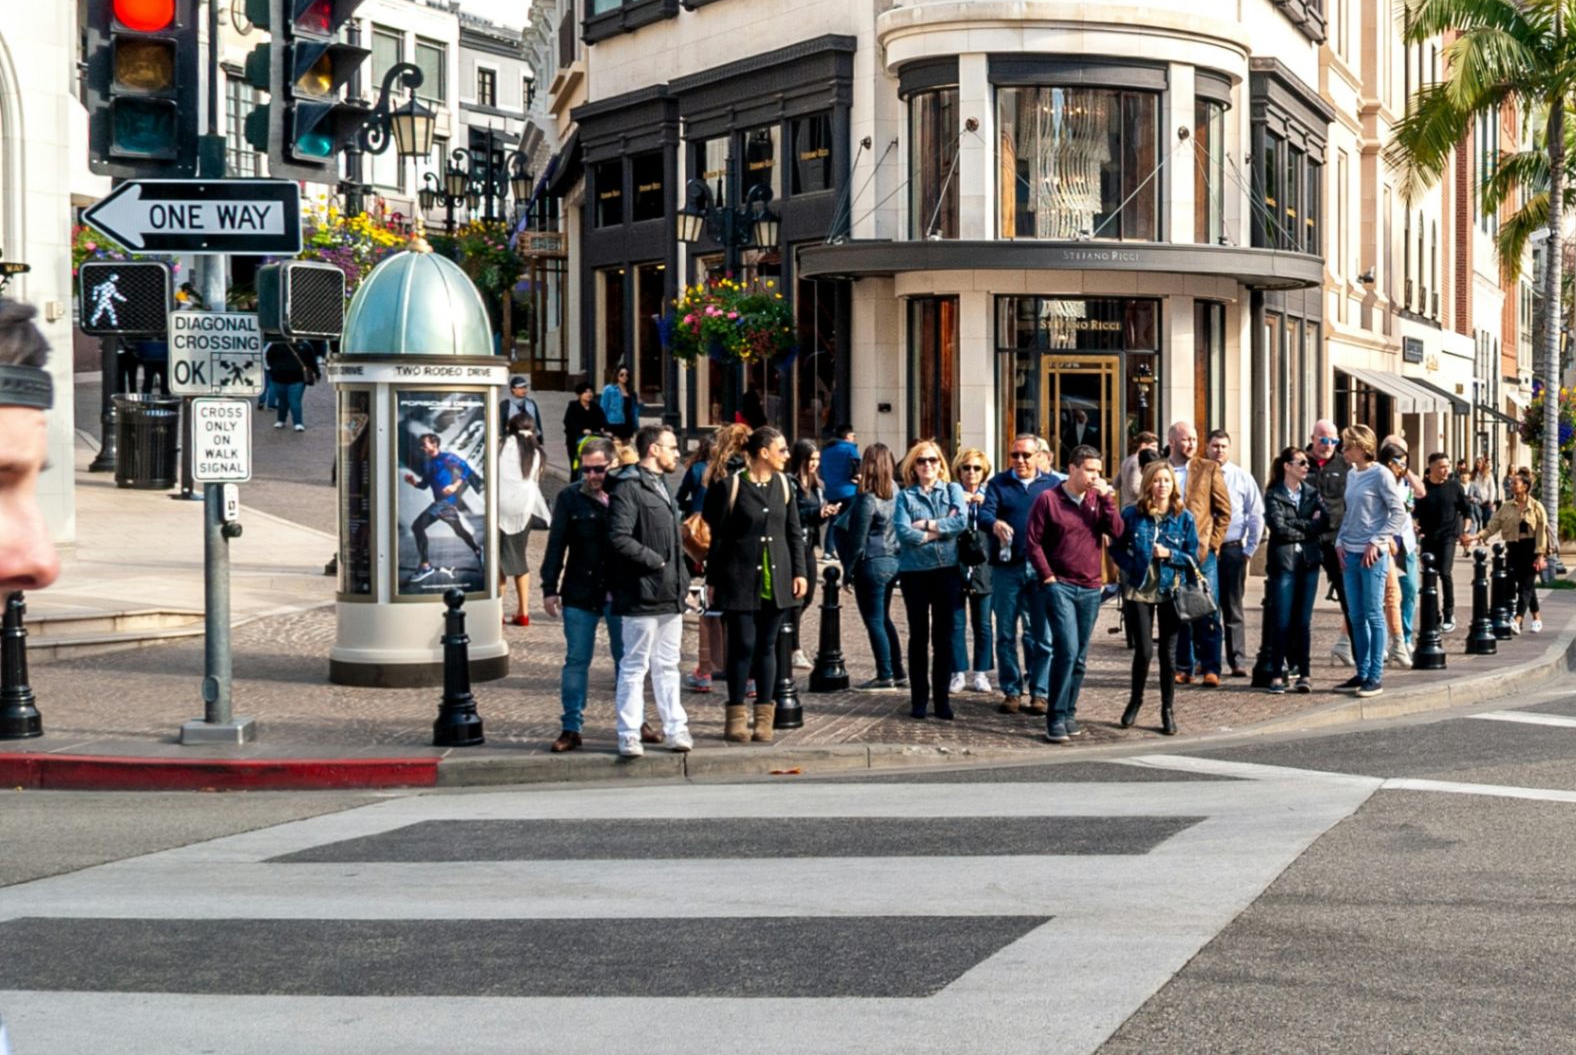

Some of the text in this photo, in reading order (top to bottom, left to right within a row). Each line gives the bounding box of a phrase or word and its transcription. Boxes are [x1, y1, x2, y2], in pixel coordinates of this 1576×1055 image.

[149, 204, 271, 230] ONE WAY
[1063, 250, 1139, 260] STEFANO RICCI
[175, 316, 257, 332] DIAGONAL
[1090, 319, 1120, 330] RICCI
[174, 334, 259, 350] CROSSING
[174, 360, 207, 385] OK
[396, 366, 491, 377] TWO RODEO DRIVE
[200, 407, 242, 418] CROSS
[205, 421, 237, 432] ONLY
[213, 435, 231, 445] ON
[205, 449, 238, 459] WALK
[200, 463, 244, 473] SIGNAL
